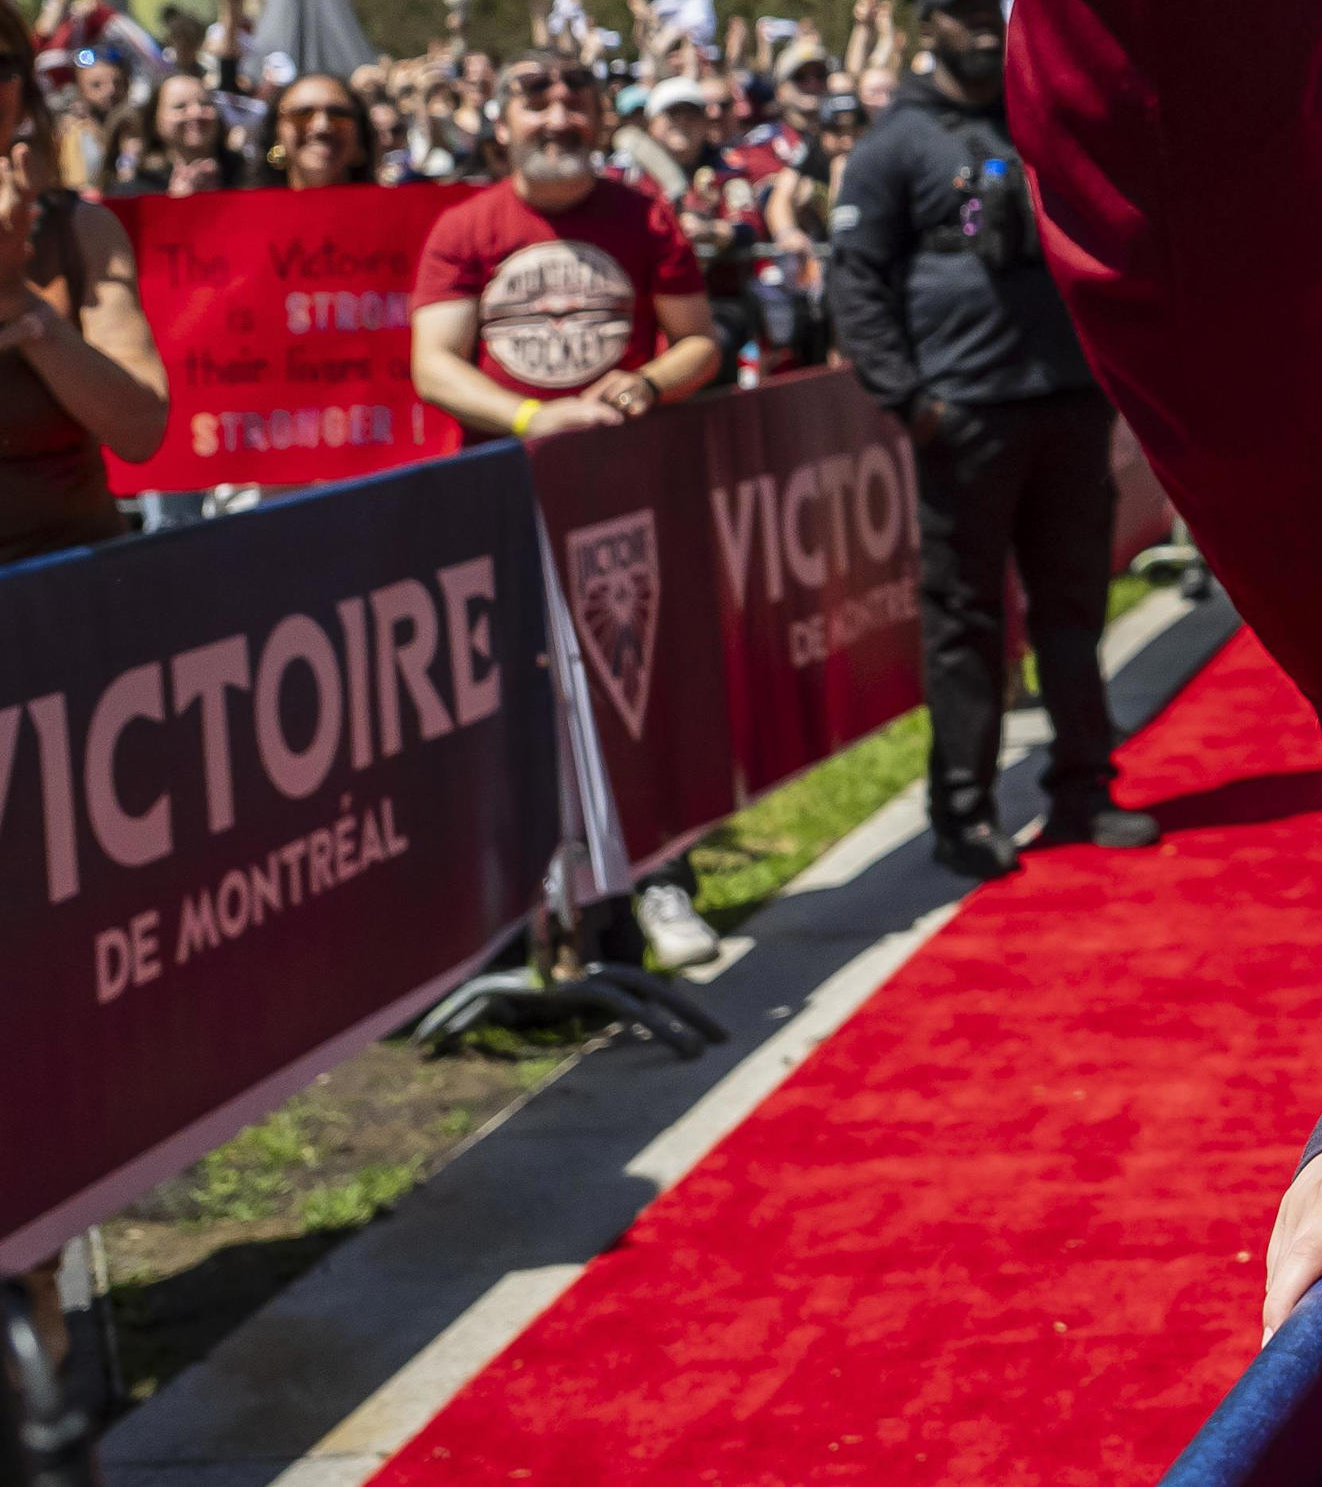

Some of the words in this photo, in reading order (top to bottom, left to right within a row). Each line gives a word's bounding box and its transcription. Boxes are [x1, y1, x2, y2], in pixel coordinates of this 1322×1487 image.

[711, 433, 921, 610] VICTOI
[95, 910, 163, 1005] DE
[176, 791, 410, 965] MONTRÉAL
